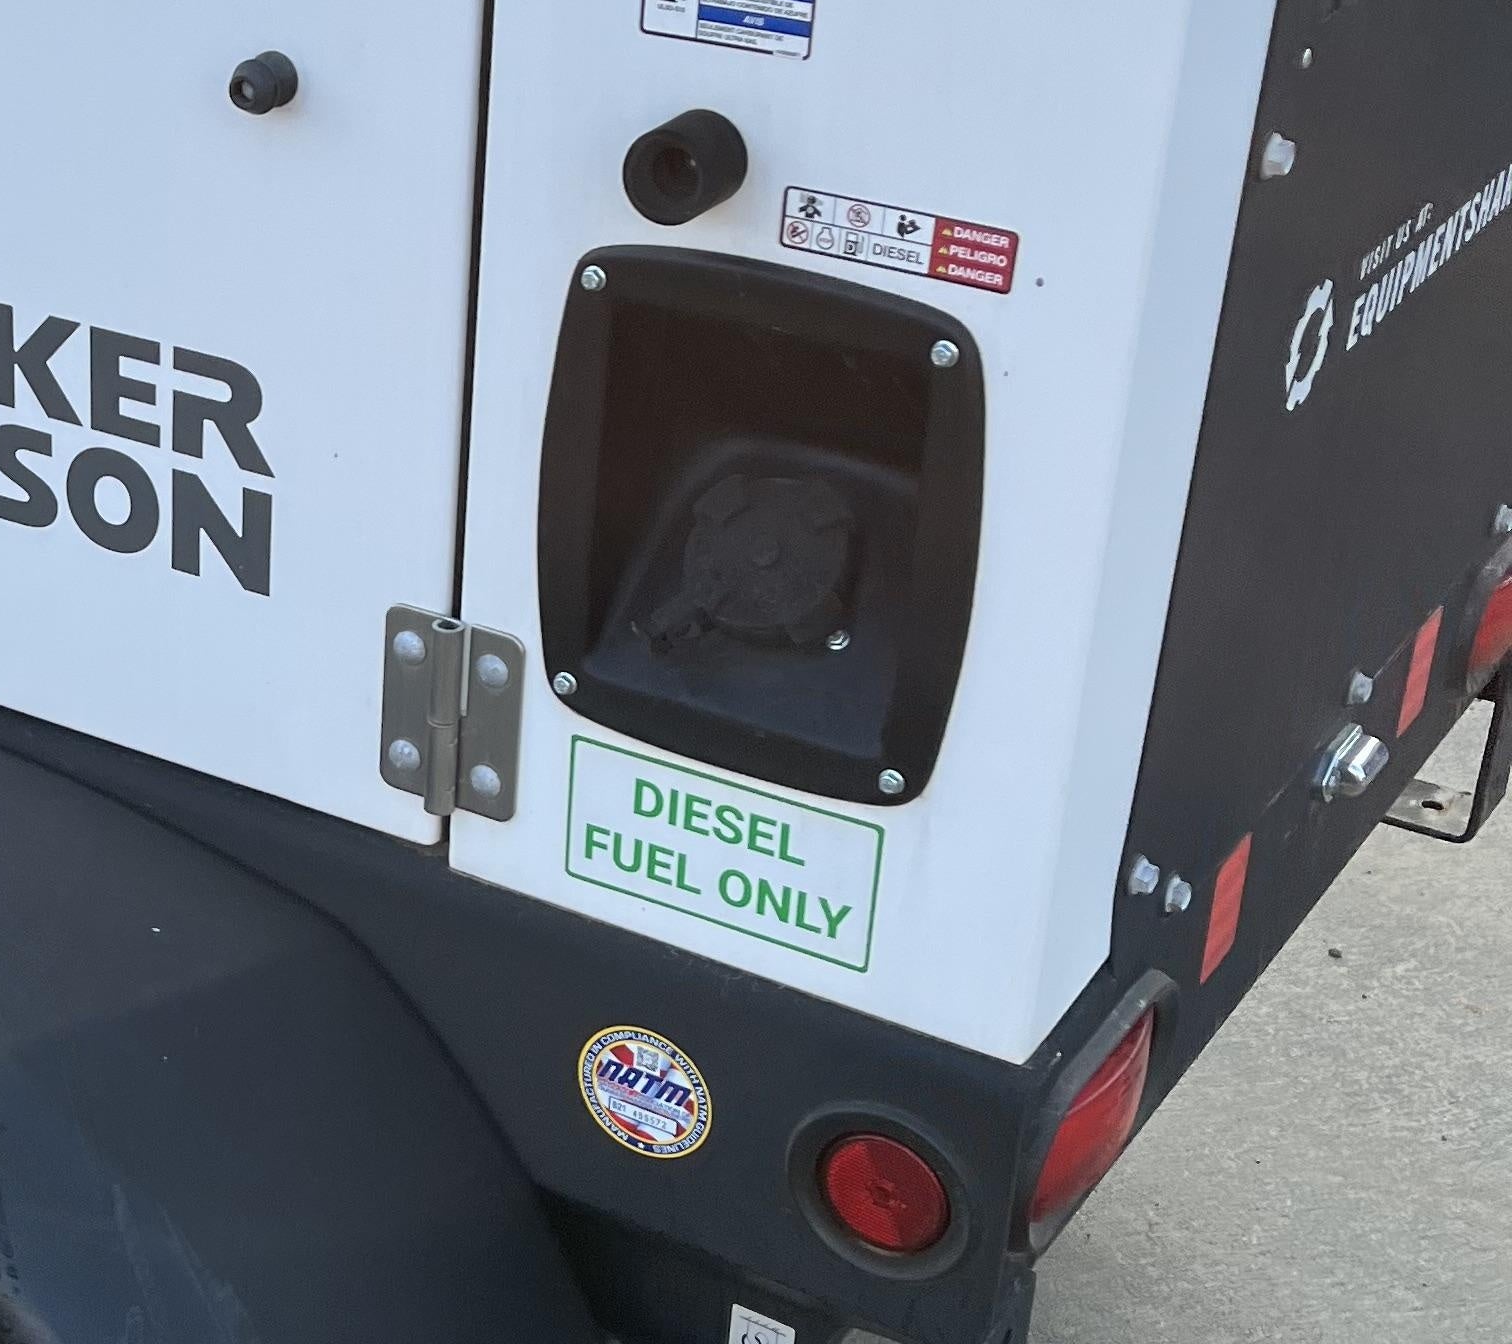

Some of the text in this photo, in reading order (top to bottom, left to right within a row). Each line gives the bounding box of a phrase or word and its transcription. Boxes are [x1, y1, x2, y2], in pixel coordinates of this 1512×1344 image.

[872, 243, 925, 265] DIESEL
[953, 226, 1011, 248] DANGER
[949, 244, 1007, 267] PELIGRO
[947, 264, 1004, 286] DANGER
[633, 777, 805, 867] DIESEL
[585, 823, 853, 939] FUEL ONLY
[599, 1059, 692, 1107] NATM
[673, 1053, 700, 1083] WITH
[694, 1086, 707, 1122] NATM
